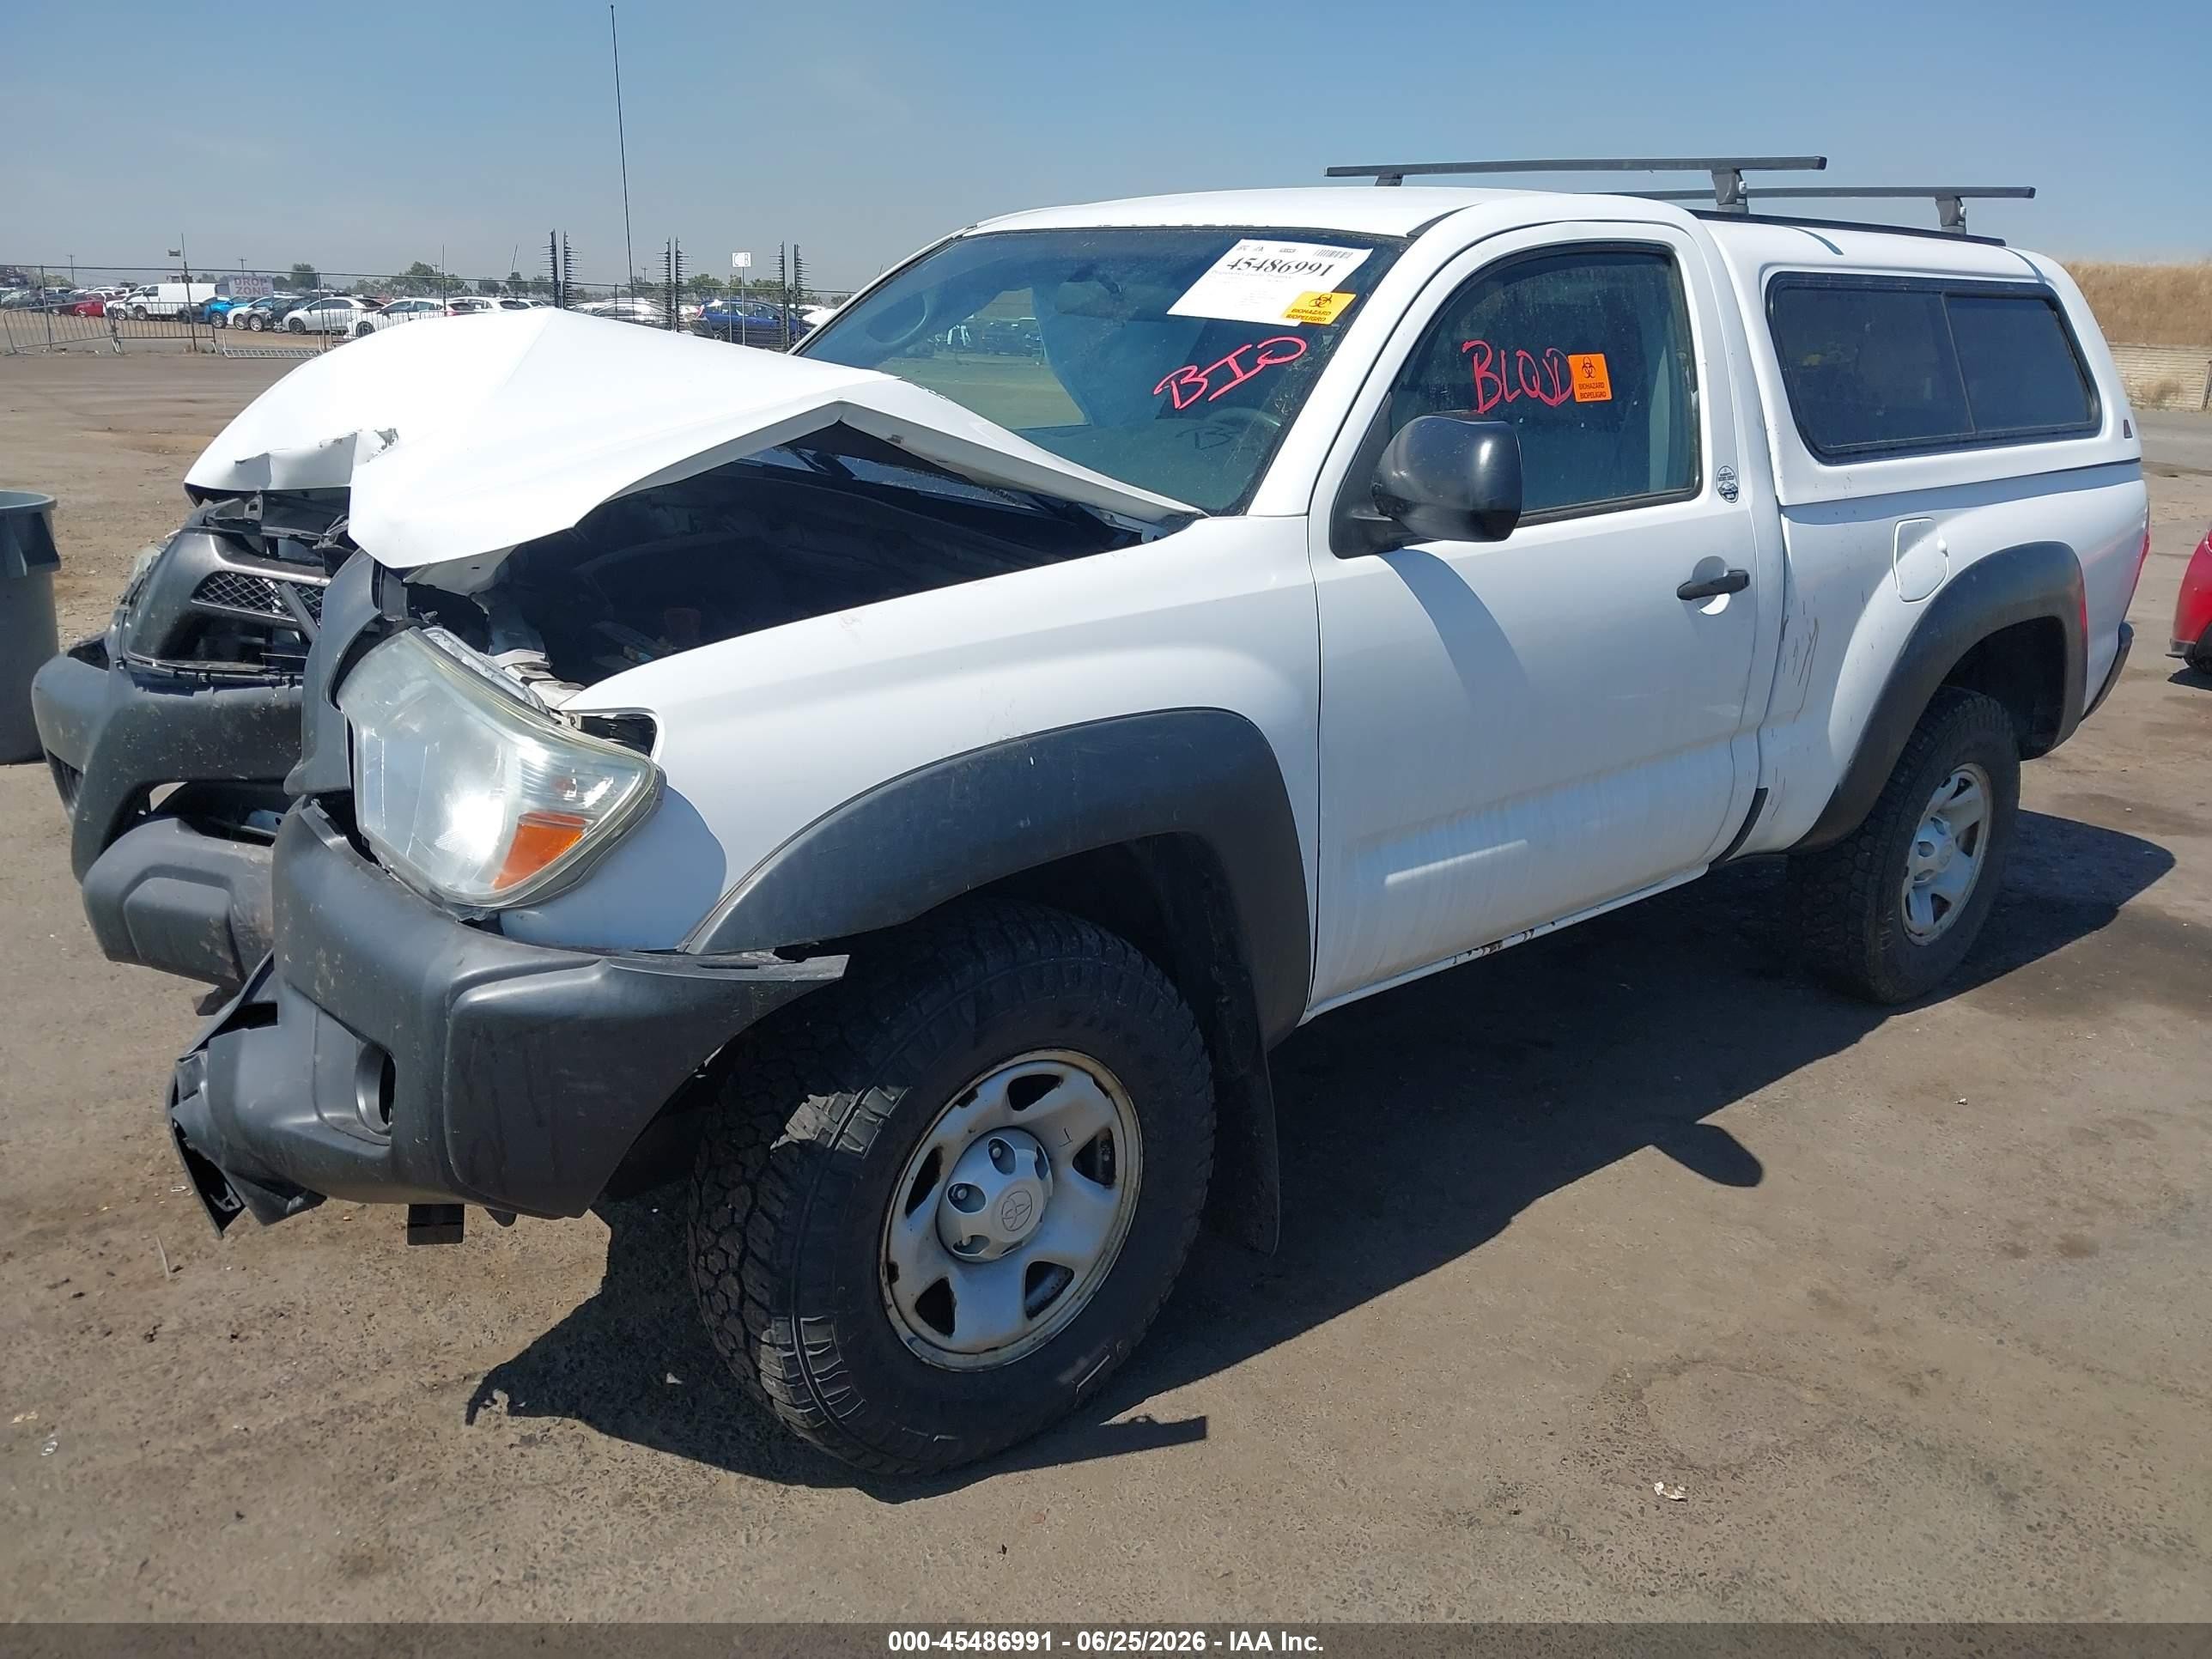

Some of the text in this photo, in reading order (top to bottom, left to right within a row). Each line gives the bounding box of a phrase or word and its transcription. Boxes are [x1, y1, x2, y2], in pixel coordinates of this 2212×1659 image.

[1227, 257, 1335, 276] 45486991
[234, 277, 268, 287] DROP
[235, 286, 269, 295] ZONE
[1153, 336, 1307, 410] BIO
